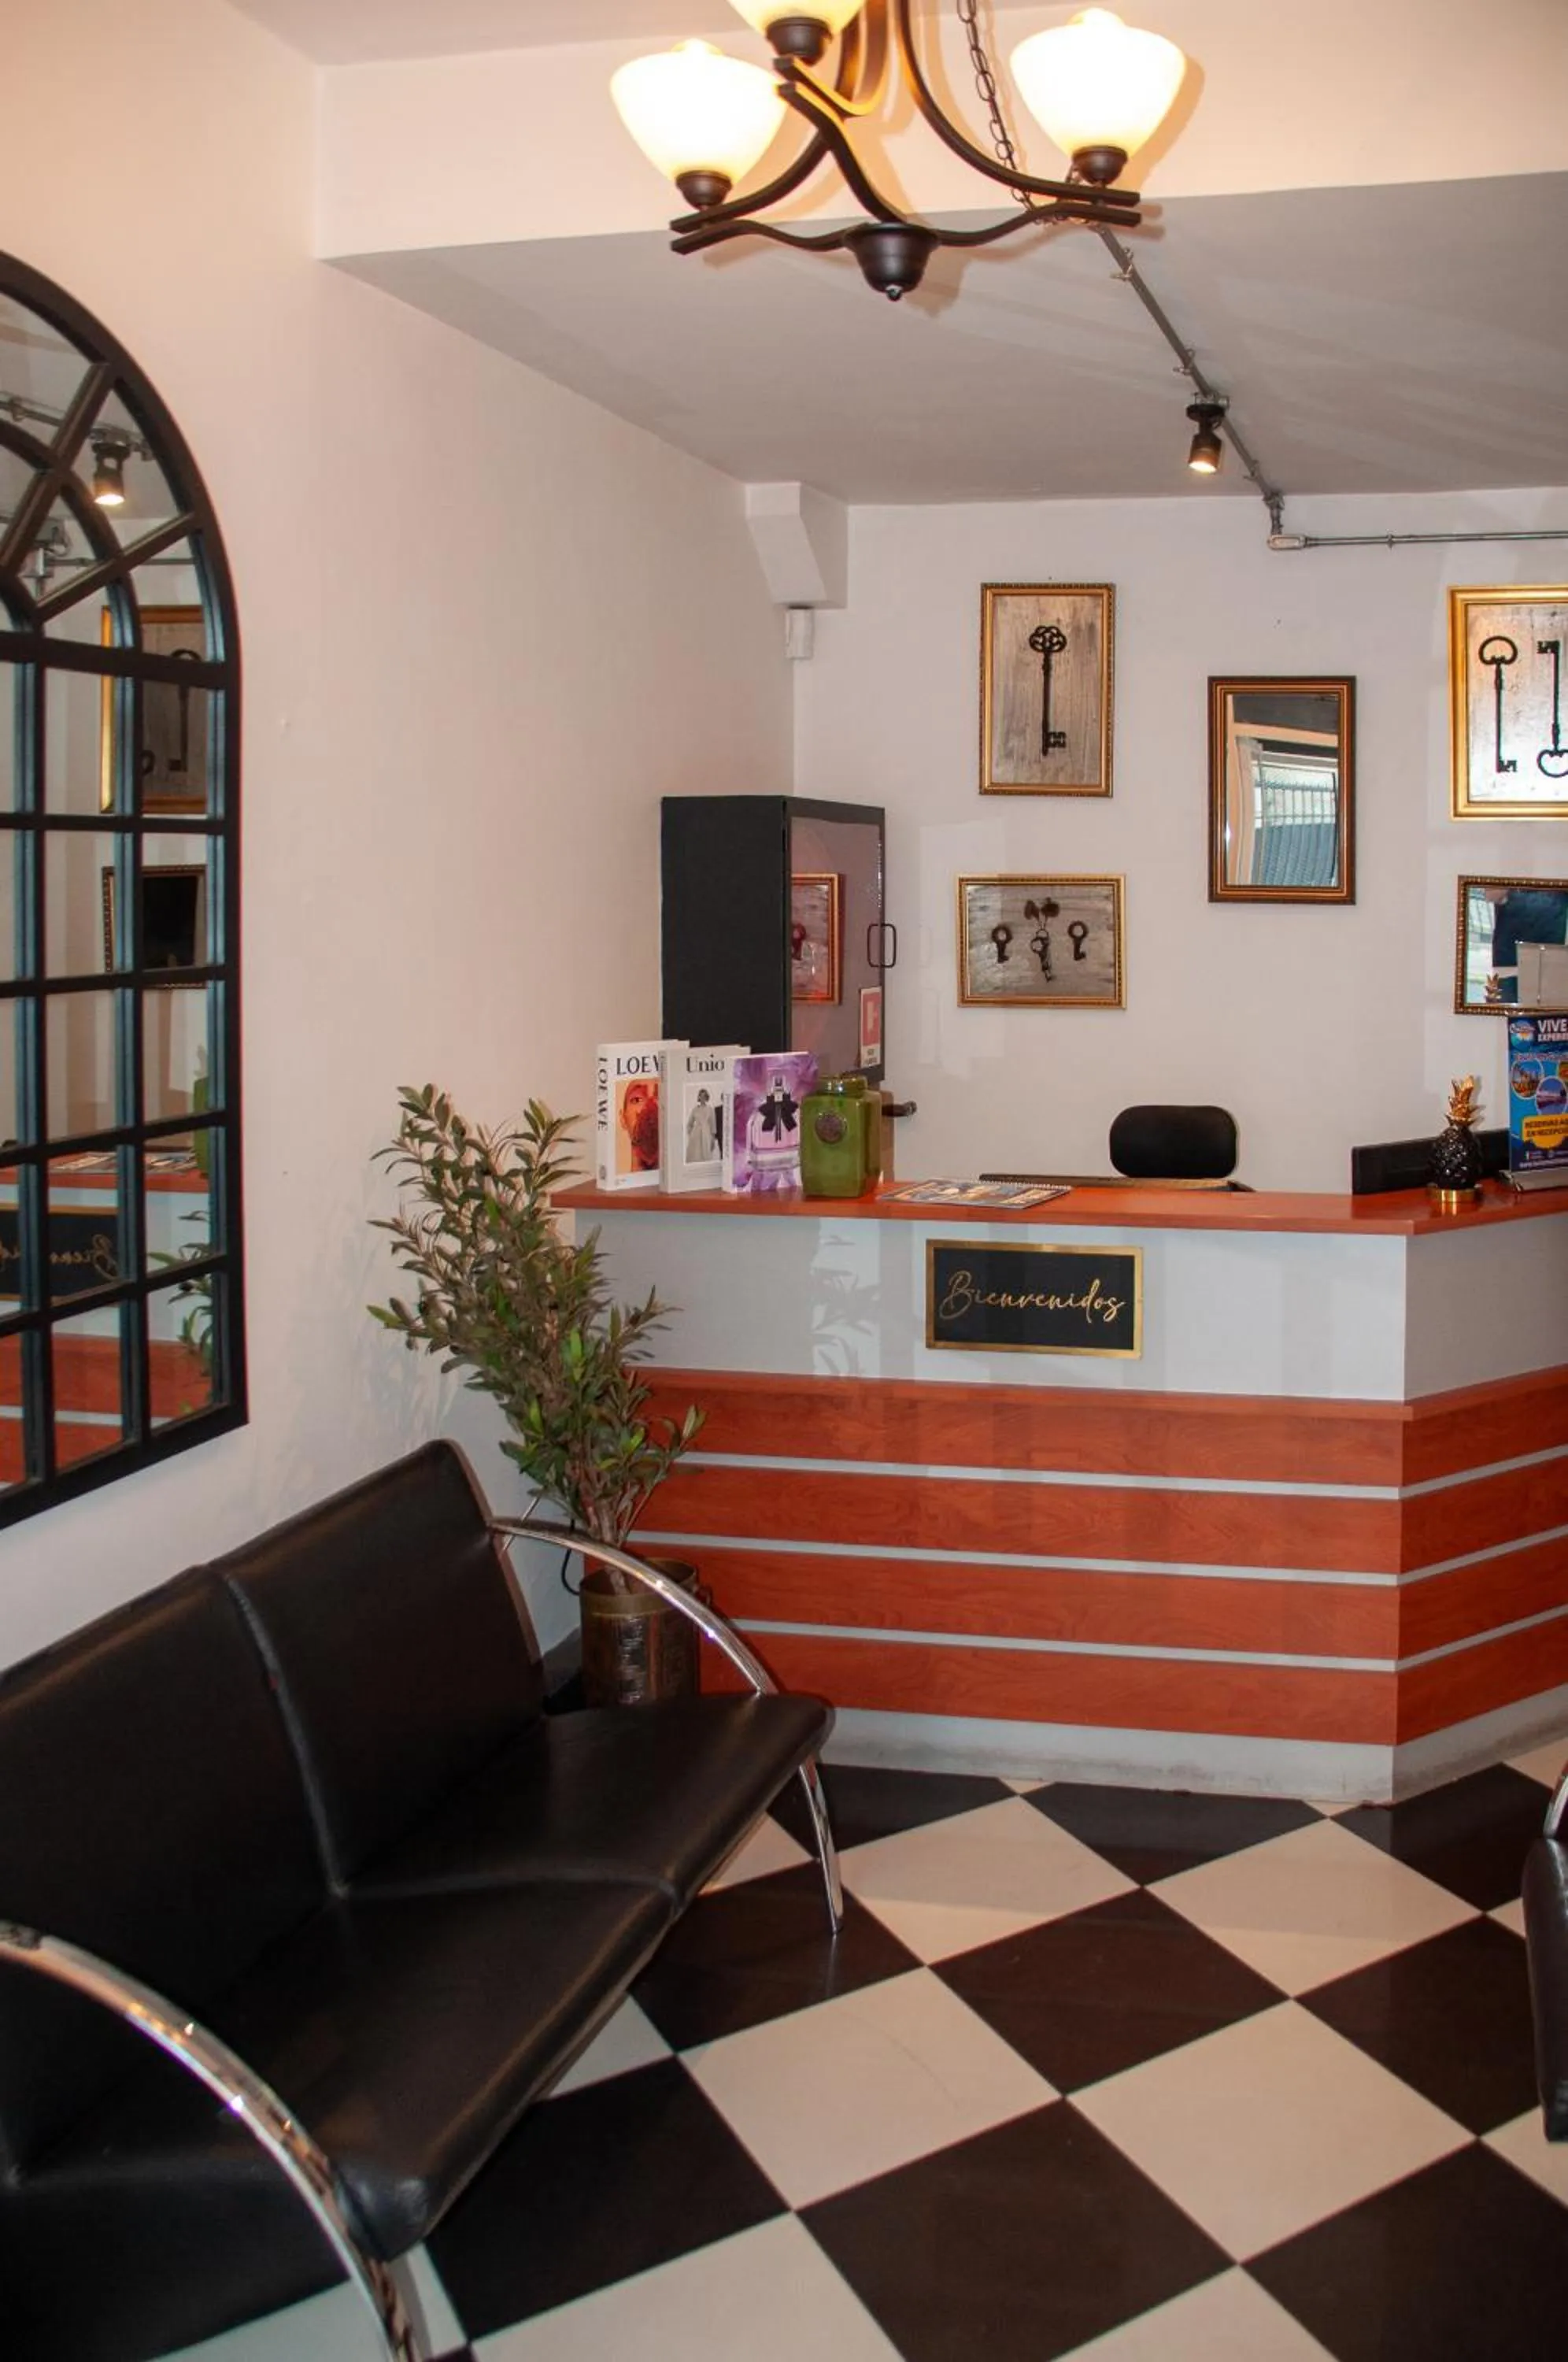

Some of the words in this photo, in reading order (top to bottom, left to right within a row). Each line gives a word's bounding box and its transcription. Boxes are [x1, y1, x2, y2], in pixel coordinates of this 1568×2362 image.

[1537, 1018, 1567, 1033] VIVE
[616, 1054, 660, 1075] LOE
[686, 1053, 725, 1073] Unio
[597, 1057, 609, 1131] LOEWE
[938, 1269, 1126, 1324] Bienvenidos
